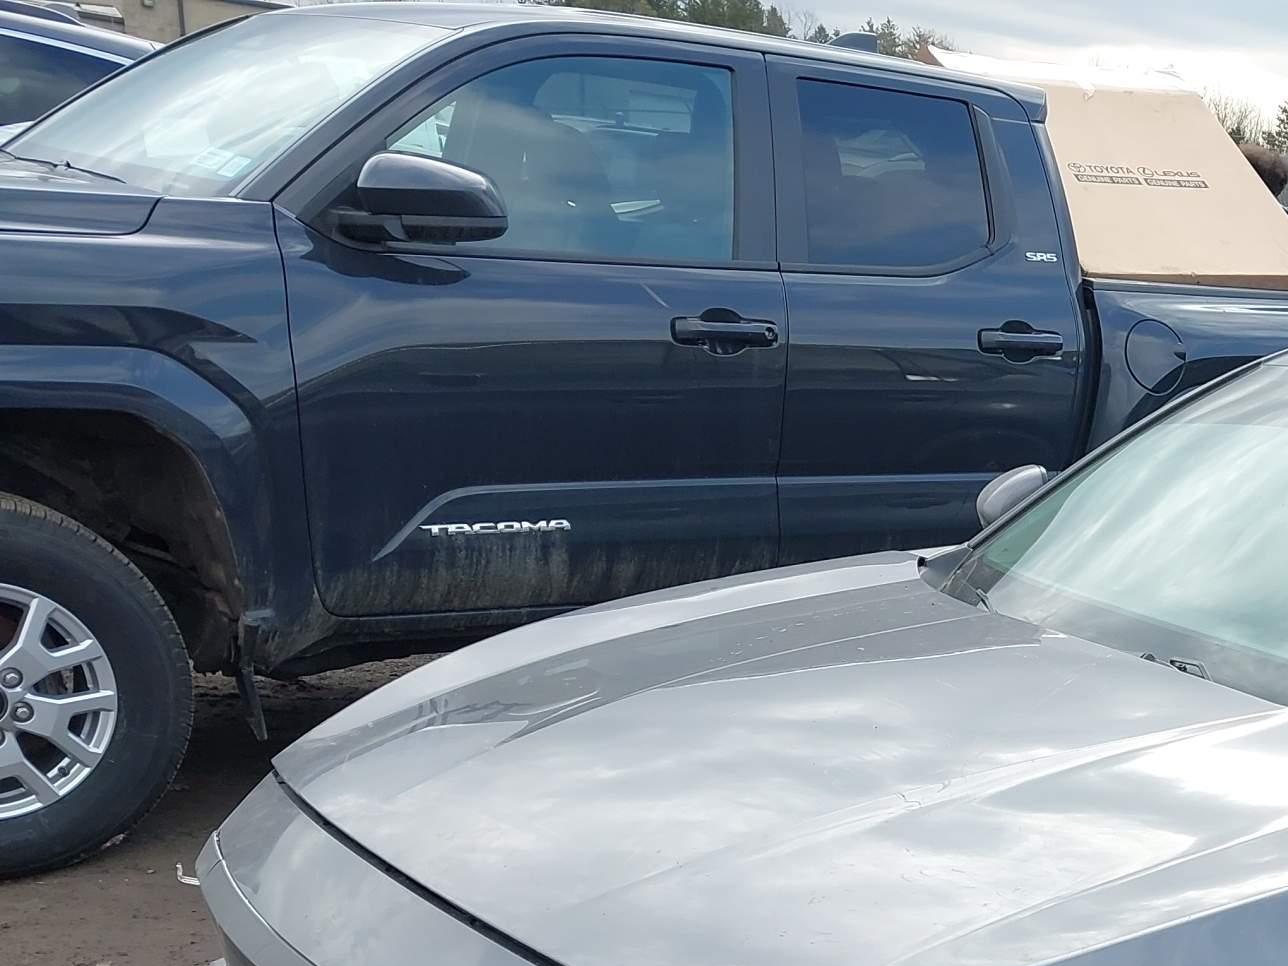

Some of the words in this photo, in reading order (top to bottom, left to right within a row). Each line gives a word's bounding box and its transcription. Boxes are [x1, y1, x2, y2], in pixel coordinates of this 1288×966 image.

[1086, 165, 1136, 175] TOYOTA
[1155, 169, 1201, 178] LEXUS
[1113, 176, 1138, 185] PARTS
[1025, 251, 1058, 262] SR5
[418, 518, 572, 537] TACOMA
